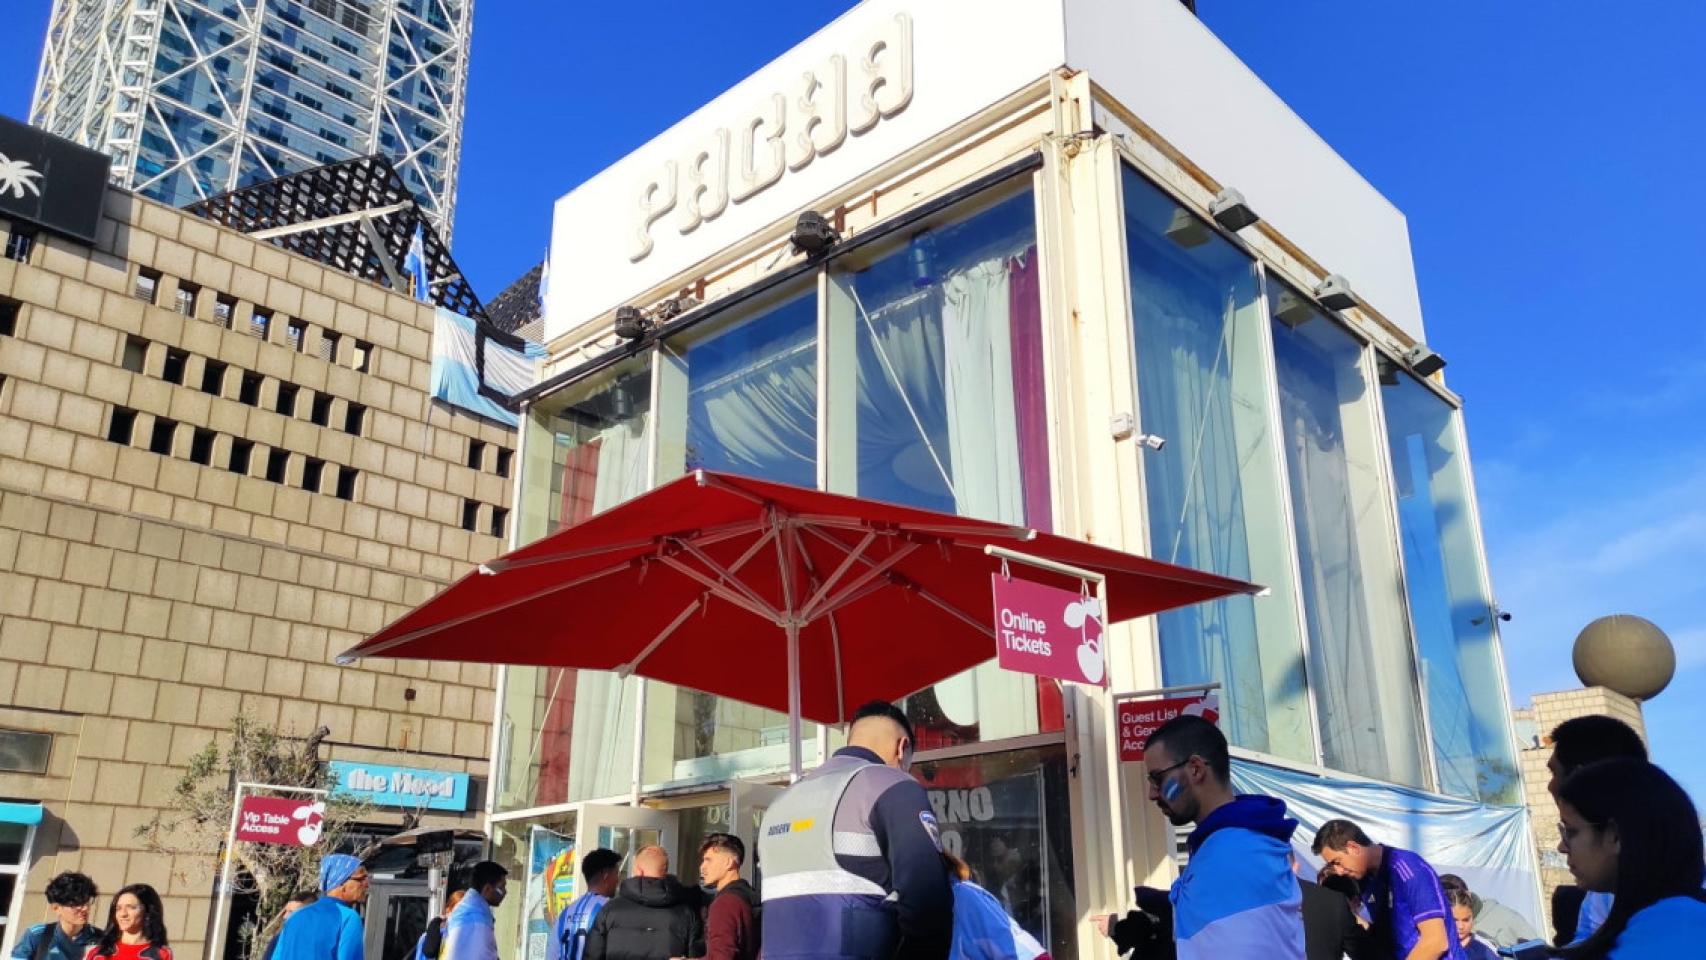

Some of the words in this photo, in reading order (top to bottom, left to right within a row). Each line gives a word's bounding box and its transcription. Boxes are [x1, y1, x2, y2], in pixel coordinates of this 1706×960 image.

[628, 12, 914, 264] PACHA
[1001, 608, 1046, 635] Online
[1001, 629, 1052, 657] Tickets
[1122, 712, 1154, 724] Guest
[1157, 708, 1178, 721] List
[1122, 726, 1131, 738] &
[1122, 739, 1145, 751] Acc
[348, 768, 387, 793] the
[927, 786, 994, 824] RNO
[240, 821, 280, 834] Access
[243, 811, 260, 823] Vip
[263, 812, 290, 825] Table
